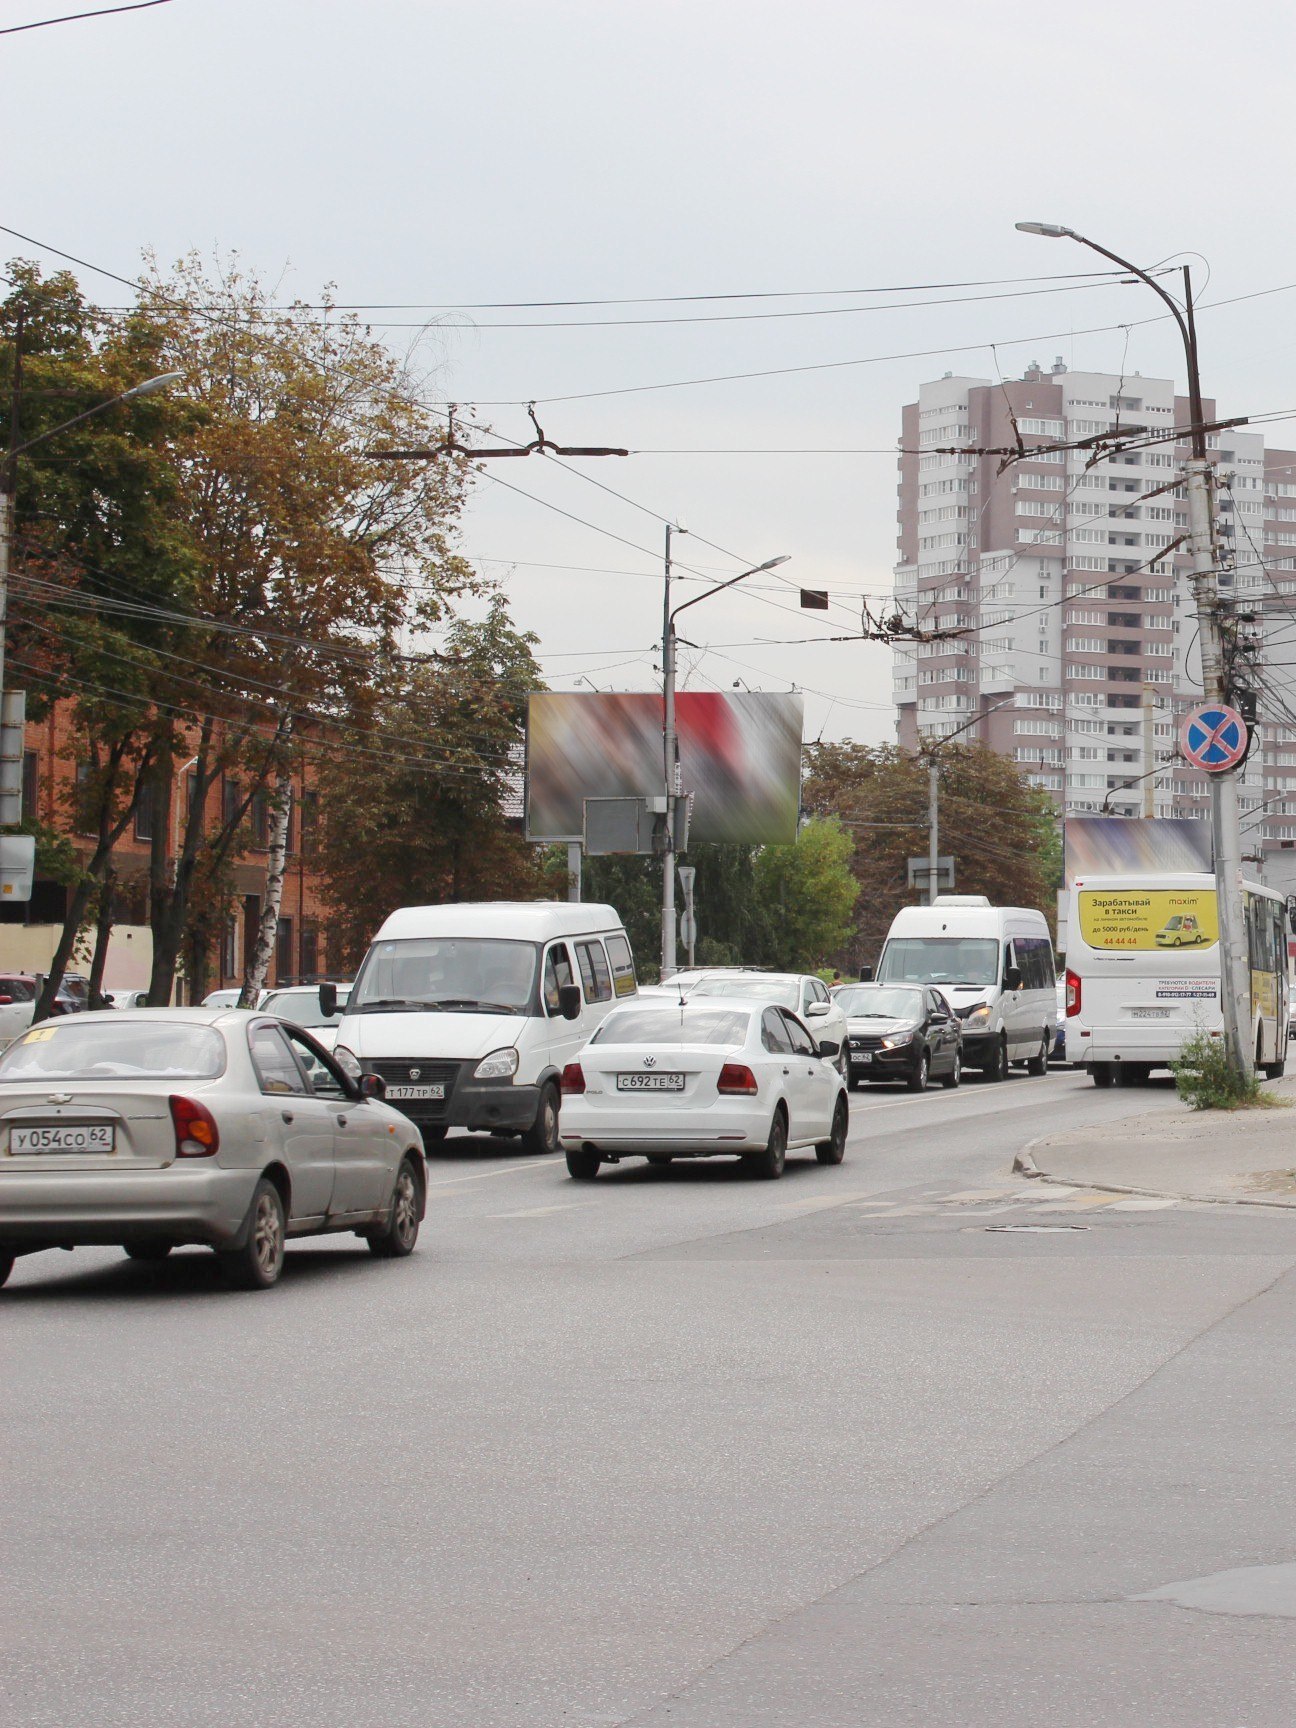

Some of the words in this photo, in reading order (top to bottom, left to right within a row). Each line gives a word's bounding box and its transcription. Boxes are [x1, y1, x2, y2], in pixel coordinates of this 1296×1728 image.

[1092, 898, 1151, 907] Зарабатывай
[668, 1075, 680, 1084] 62
[89, 1128, 107, 1141] 62
